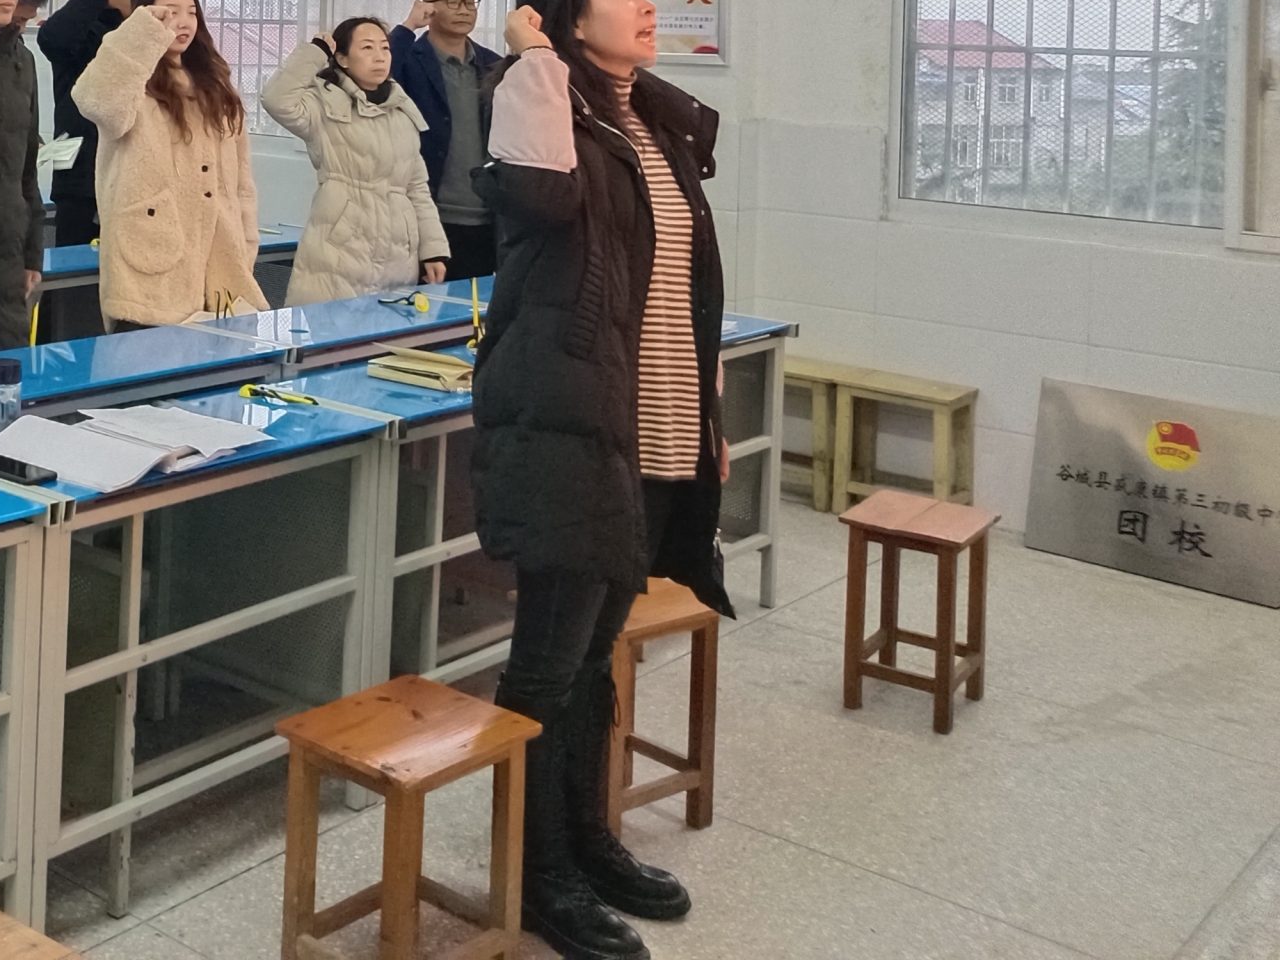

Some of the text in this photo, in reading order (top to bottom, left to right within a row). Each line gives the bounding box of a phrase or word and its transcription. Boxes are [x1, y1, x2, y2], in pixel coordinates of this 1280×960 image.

[1056, 464, 1280, 526] 谷城县盛康镇第三初级中
